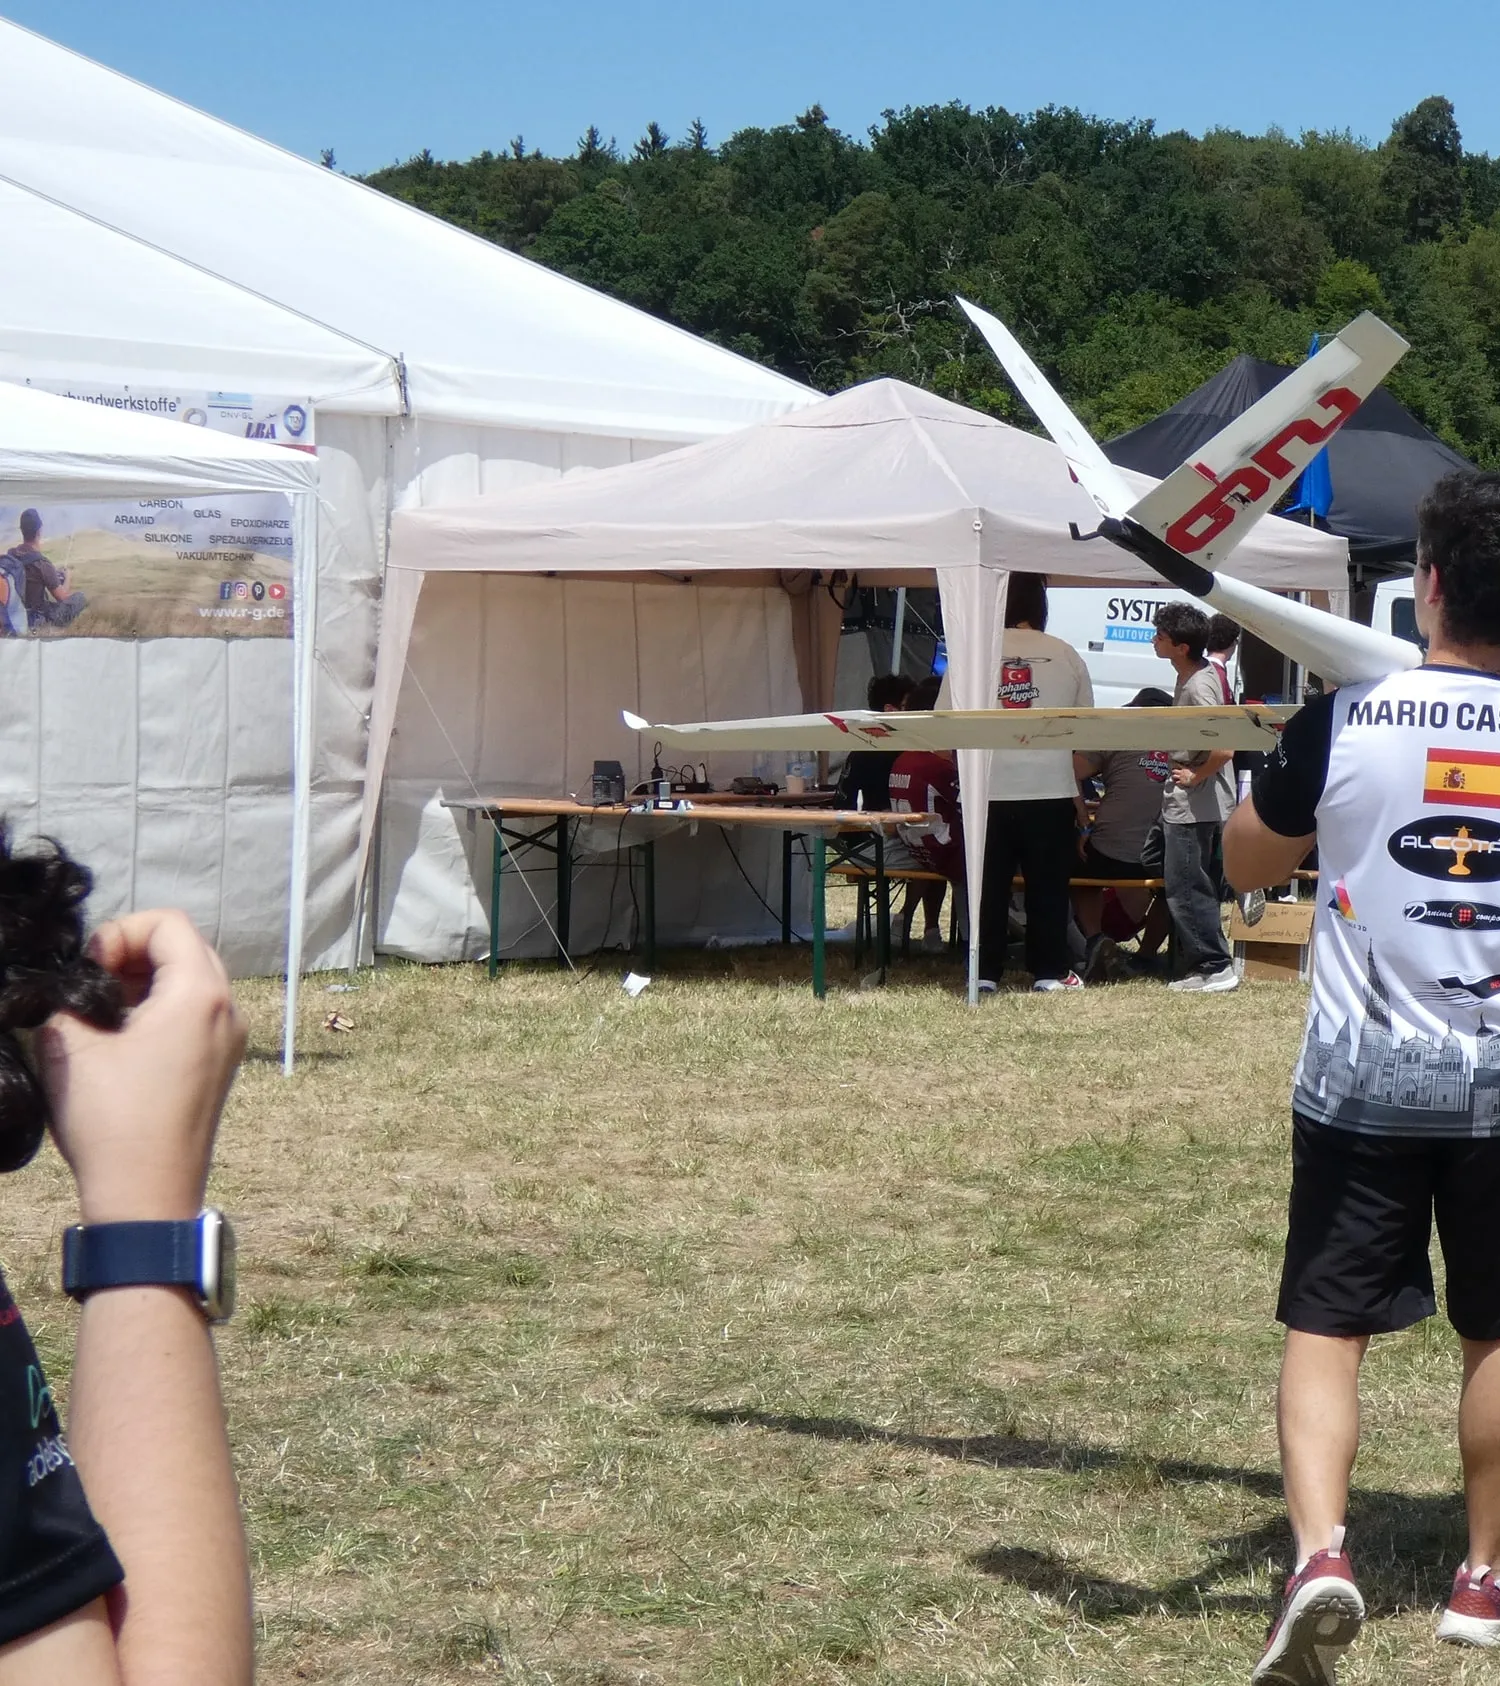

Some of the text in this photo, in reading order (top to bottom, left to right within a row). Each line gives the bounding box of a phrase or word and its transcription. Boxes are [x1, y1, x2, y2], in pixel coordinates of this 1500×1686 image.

[139, 500, 183, 509] CARBON
[193, 509, 222, 519] GLAS
[114, 515, 155, 525] ARAMID
[230, 518, 290, 529] EPOXIDHARZE
[144, 533, 193, 543] SILIKONE
[176, 551, 255, 562] VAKUUMTECHNIK
[199, 606, 285, 621] www.r-g.de
[1111, 627, 1155, 642] AUTOVE
[1347, 699, 1449, 729] MARIO
